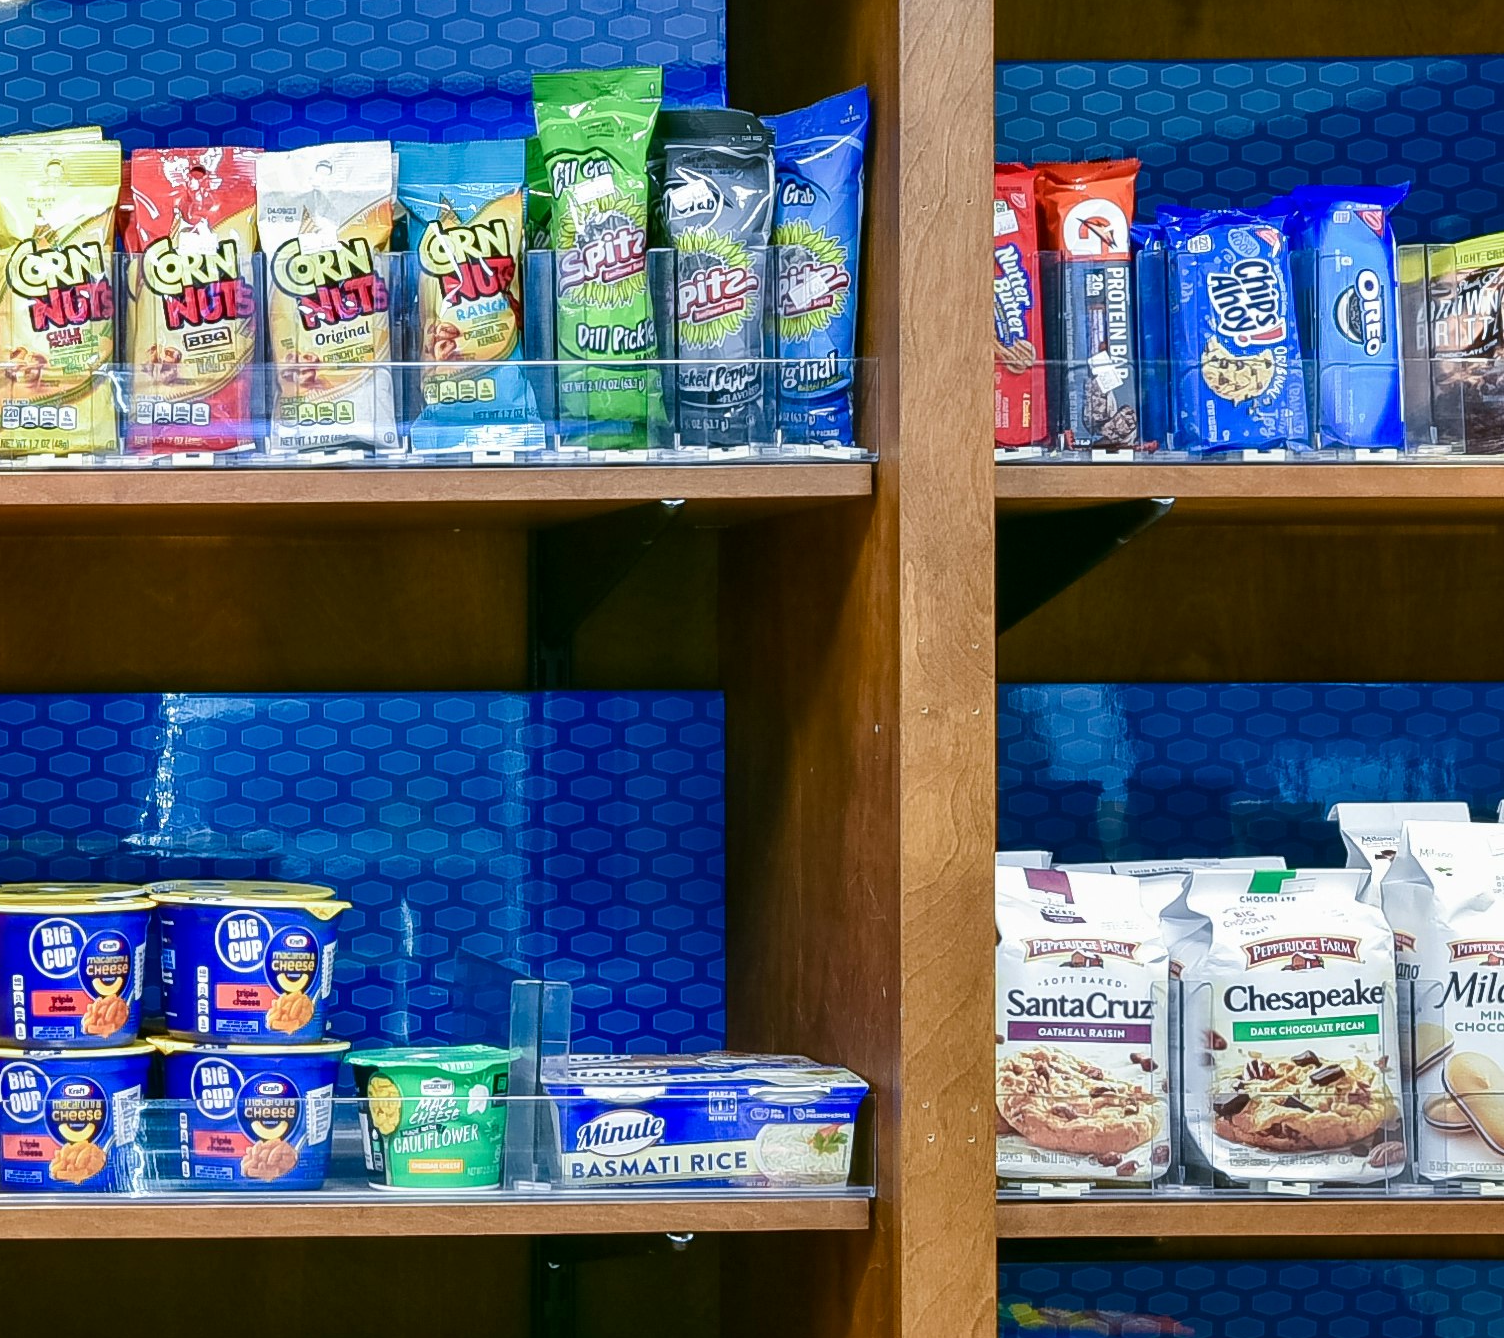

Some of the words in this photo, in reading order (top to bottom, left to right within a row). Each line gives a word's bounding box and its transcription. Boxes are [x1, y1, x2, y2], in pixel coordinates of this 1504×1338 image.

[147, 239, 237, 296] CORN
[1108, 266, 1129, 345] PROTEIN
[1231, 258, 1278, 328] Chips
[456, 299, 510, 322] RANCH
[1356, 270, 1386, 356] OREO
[189, 333, 227, 345] BBQ
[315, 323, 370, 346] Original
[578, 324, 605, 351] Dill
[41, 926, 73, 947] BIG
[41, 946, 76, 969] CUP
[1251, 939, 1316, 961] PEPPERIDGE
[86, 962, 128, 976] CHEESE
[1224, 978, 1384, 1017] Chesapeake
[1037, 1026, 1084, 1038] OATMEAL
[1087, 1027, 1125, 1040] RAISIN
[1250, 1025, 1277, 1038] DARK
[1280, 1022, 1332, 1036] CHOCOLATE
[1335, 1020, 1365, 1032] PECAN
[394, 1124, 478, 1155] CAULIFLOWER
[576, 1114, 663, 1151] Minute
[572, 1155, 680, 1179] BASMATI
[690, 1151, 748, 1173] RICE
